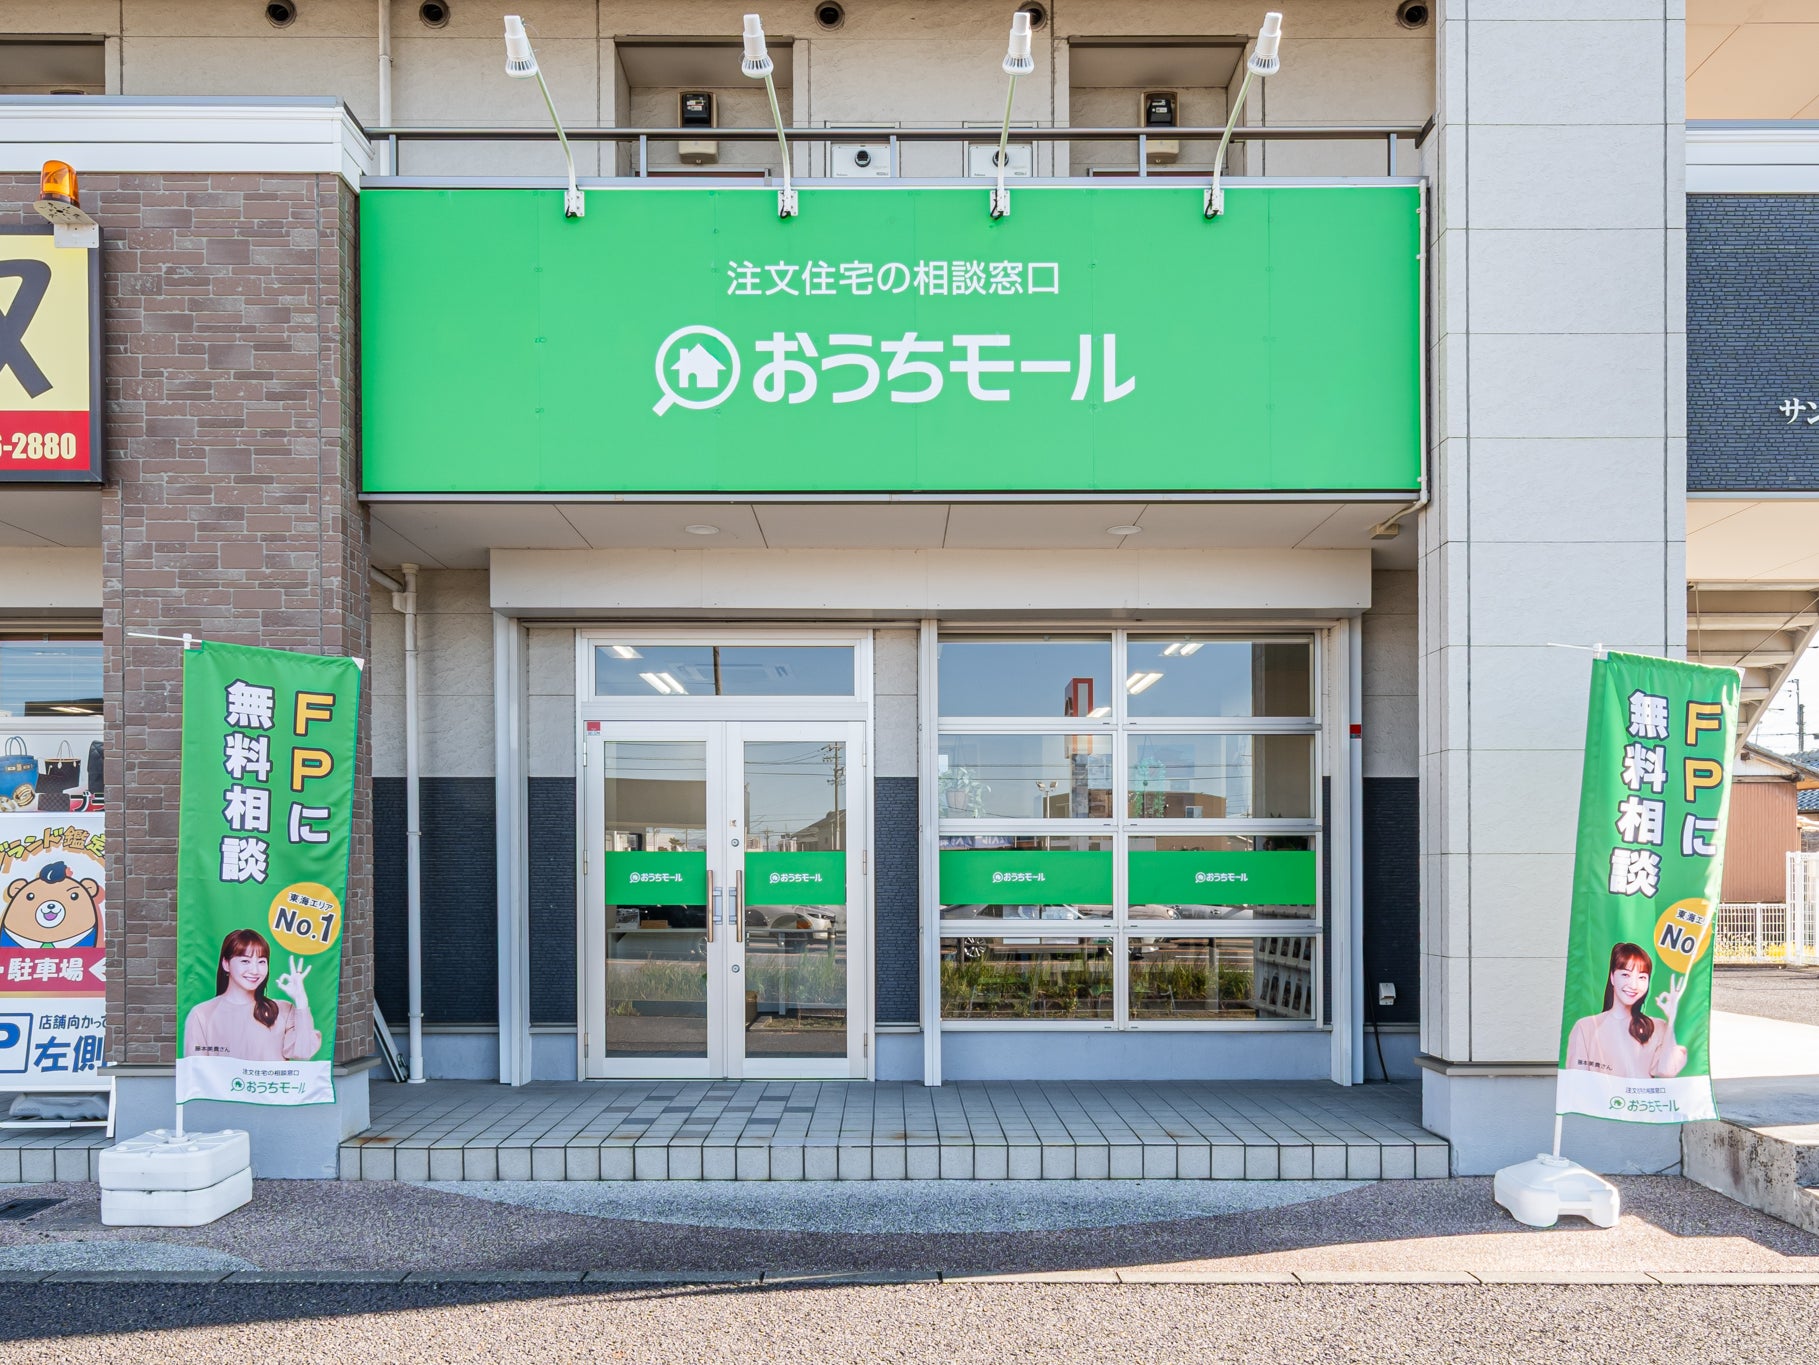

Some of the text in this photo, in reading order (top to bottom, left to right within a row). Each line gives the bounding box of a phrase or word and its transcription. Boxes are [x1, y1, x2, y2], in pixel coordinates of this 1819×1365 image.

[726, 259, 1060, 296] 注文住宅の相談窓口
[752, 331, 1136, 404] おうちモール
[0, 432, 76, 460] -2880
[219, 678, 276, 884] 無料相談
[288, 690, 336, 844] FPに
[1608, 688, 1670, 898] 無料相談
[640, 872, 683, 882] おうちモール
[780, 872, 823, 882] おうちモール
[1003, 872, 1046, 882] おうちモール
[1206, 872, 1249, 882] おうちモール
[289, 893, 334, 911] 東海エリア
[274, 906, 336, 943] No.1
[7, 957, 84, 982] 駐車場
[33, 1035, 107, 1073] 左側
[246, 1080, 306, 1094] おうちモール
